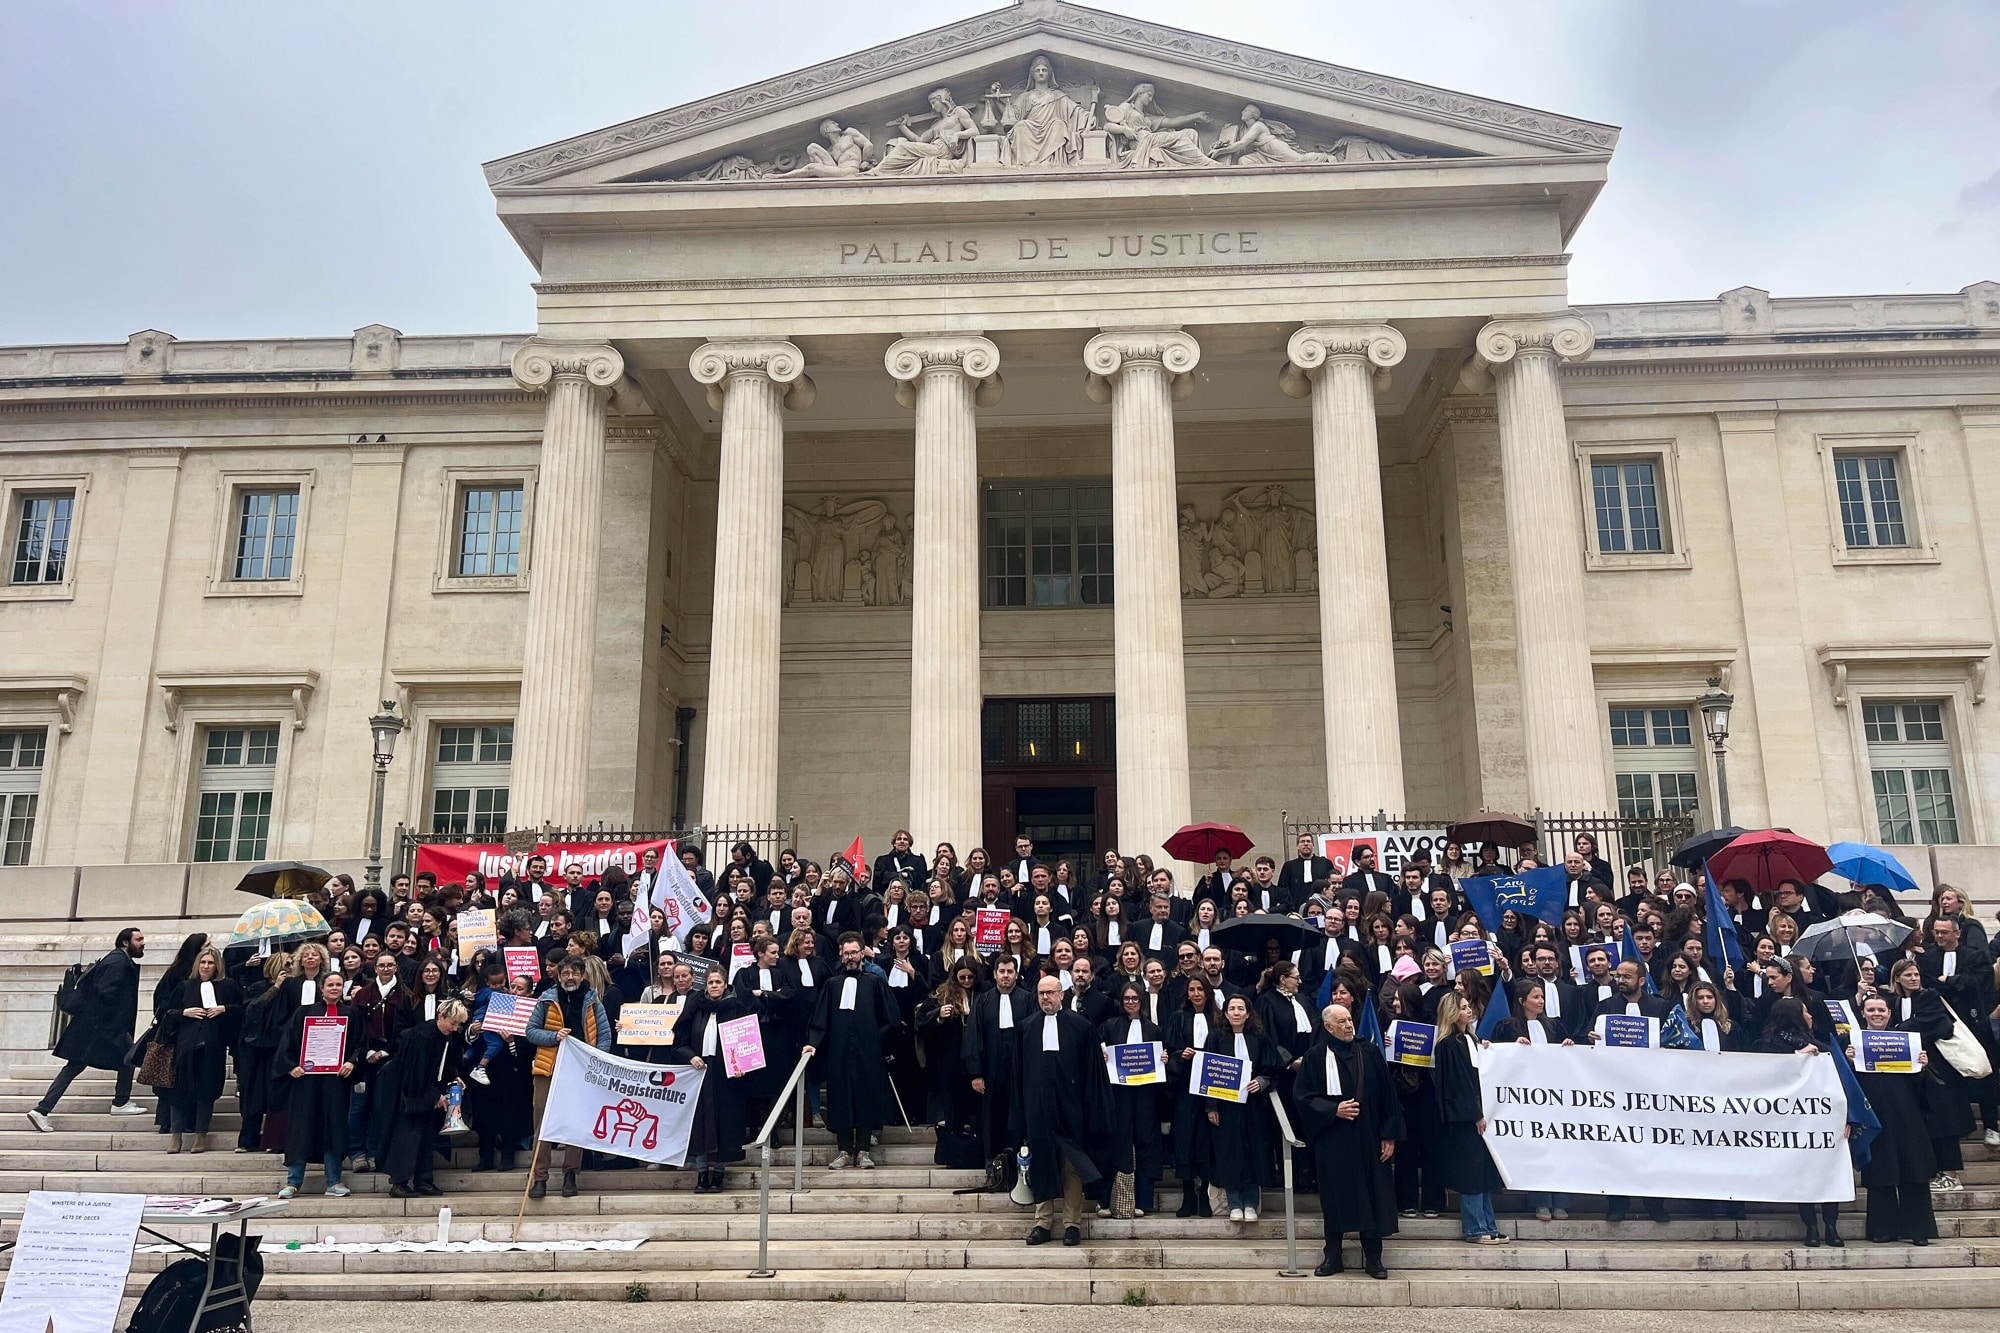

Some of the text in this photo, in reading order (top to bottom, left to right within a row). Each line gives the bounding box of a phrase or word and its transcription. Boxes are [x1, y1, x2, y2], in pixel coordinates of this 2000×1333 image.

[840, 232, 1258, 264] PALAIS DE JUSTICE
[478, 848, 636, 878] Jusie bradée
[670, 882, 702, 924] Magistratur
[684, 959, 709, 968] COUPABLE
[588, 1056, 647, 1083] Syndicat
[1211, 1059, 1234, 1067] Qu'importe
[585, 1071, 687, 1104] de la Magistrature
[1495, 1086, 1832, 1115] UNION DES JEUNES AVOCATS
[1494, 1119, 1524, 1138] DU
[1531, 1121, 1645, 1144] BARREAU
[1651, 1126, 1686, 1145] DE
[1692, 1128, 1836, 1149] MARSEILLE
